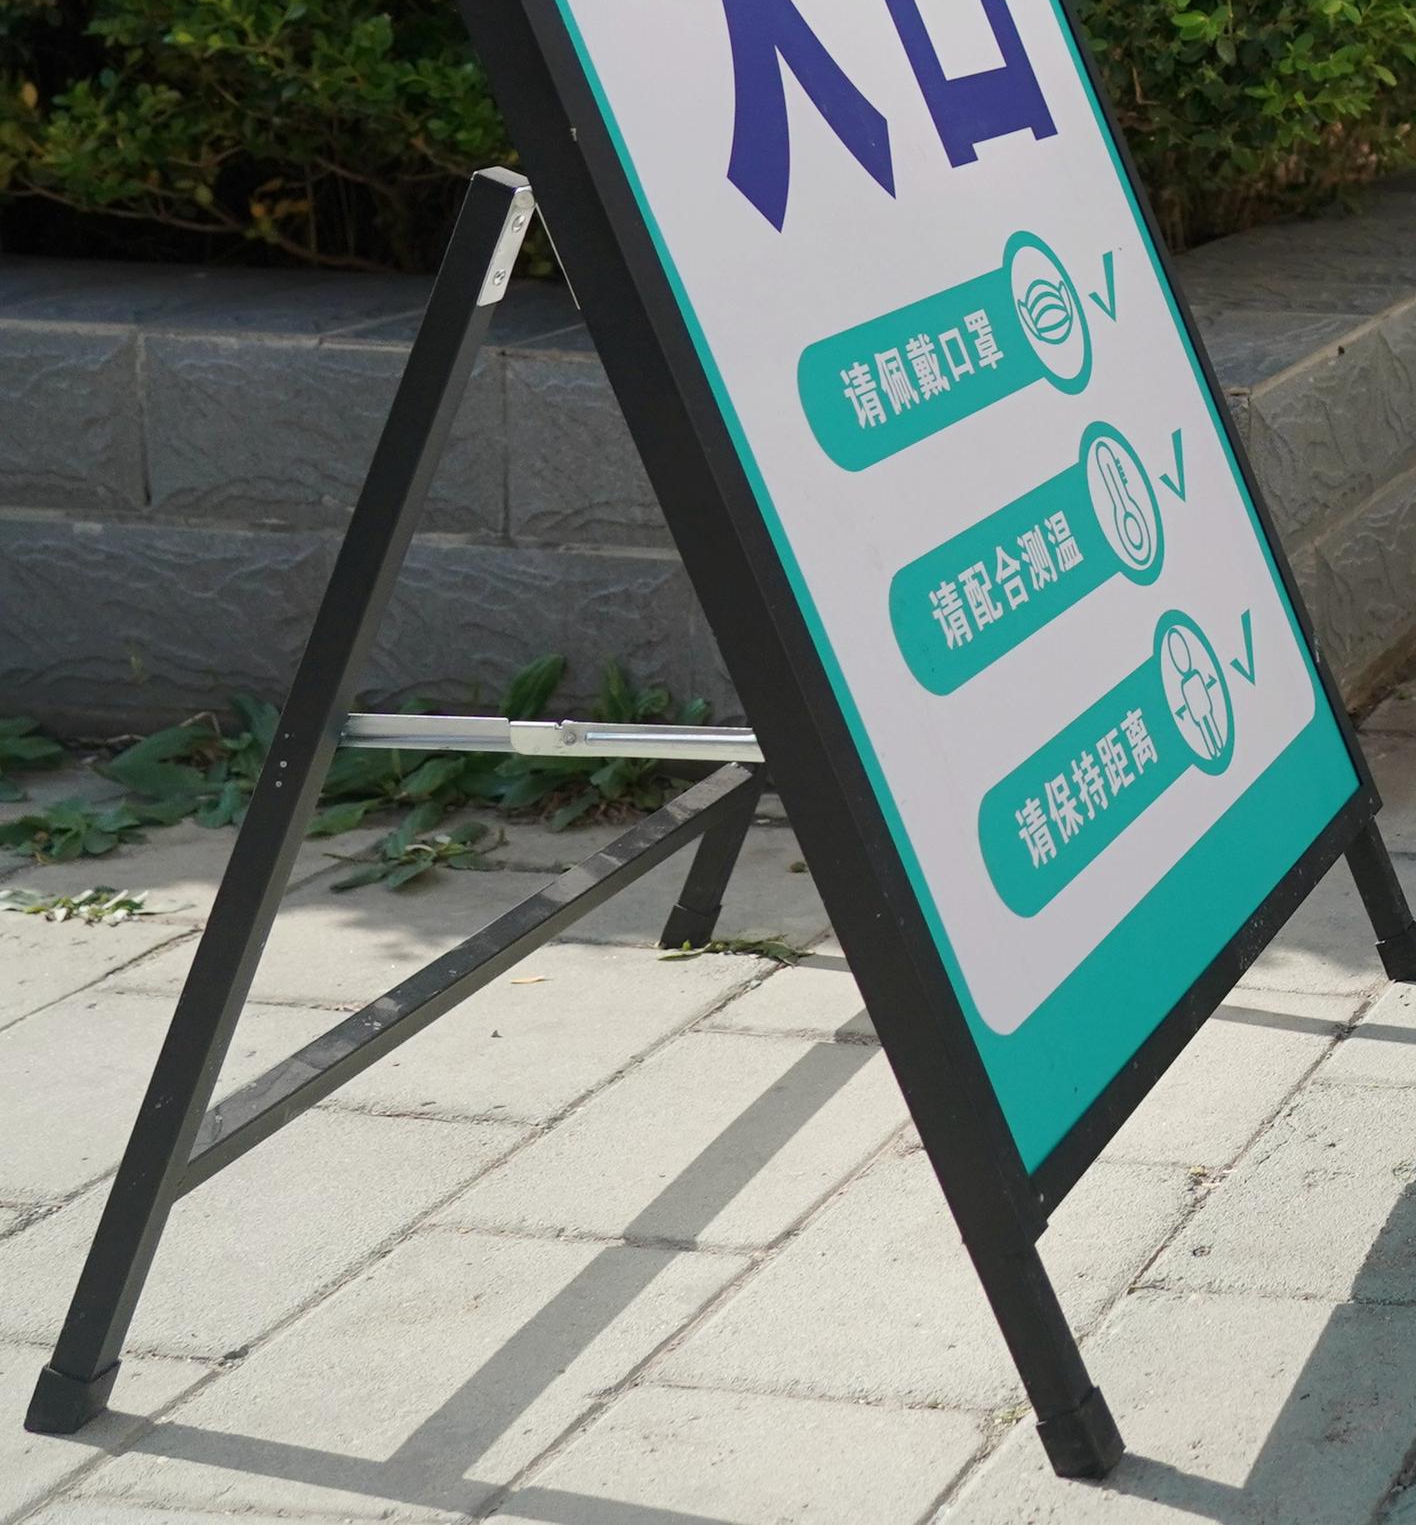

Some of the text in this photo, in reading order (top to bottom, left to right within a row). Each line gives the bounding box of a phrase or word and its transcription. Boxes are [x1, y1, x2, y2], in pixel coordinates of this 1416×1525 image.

[839, 309, 1005, 429] 请佩戴口罩
[928, 510, 1084, 651] 请配合测温
[1014, 707, 1159, 871] 请保持距离
